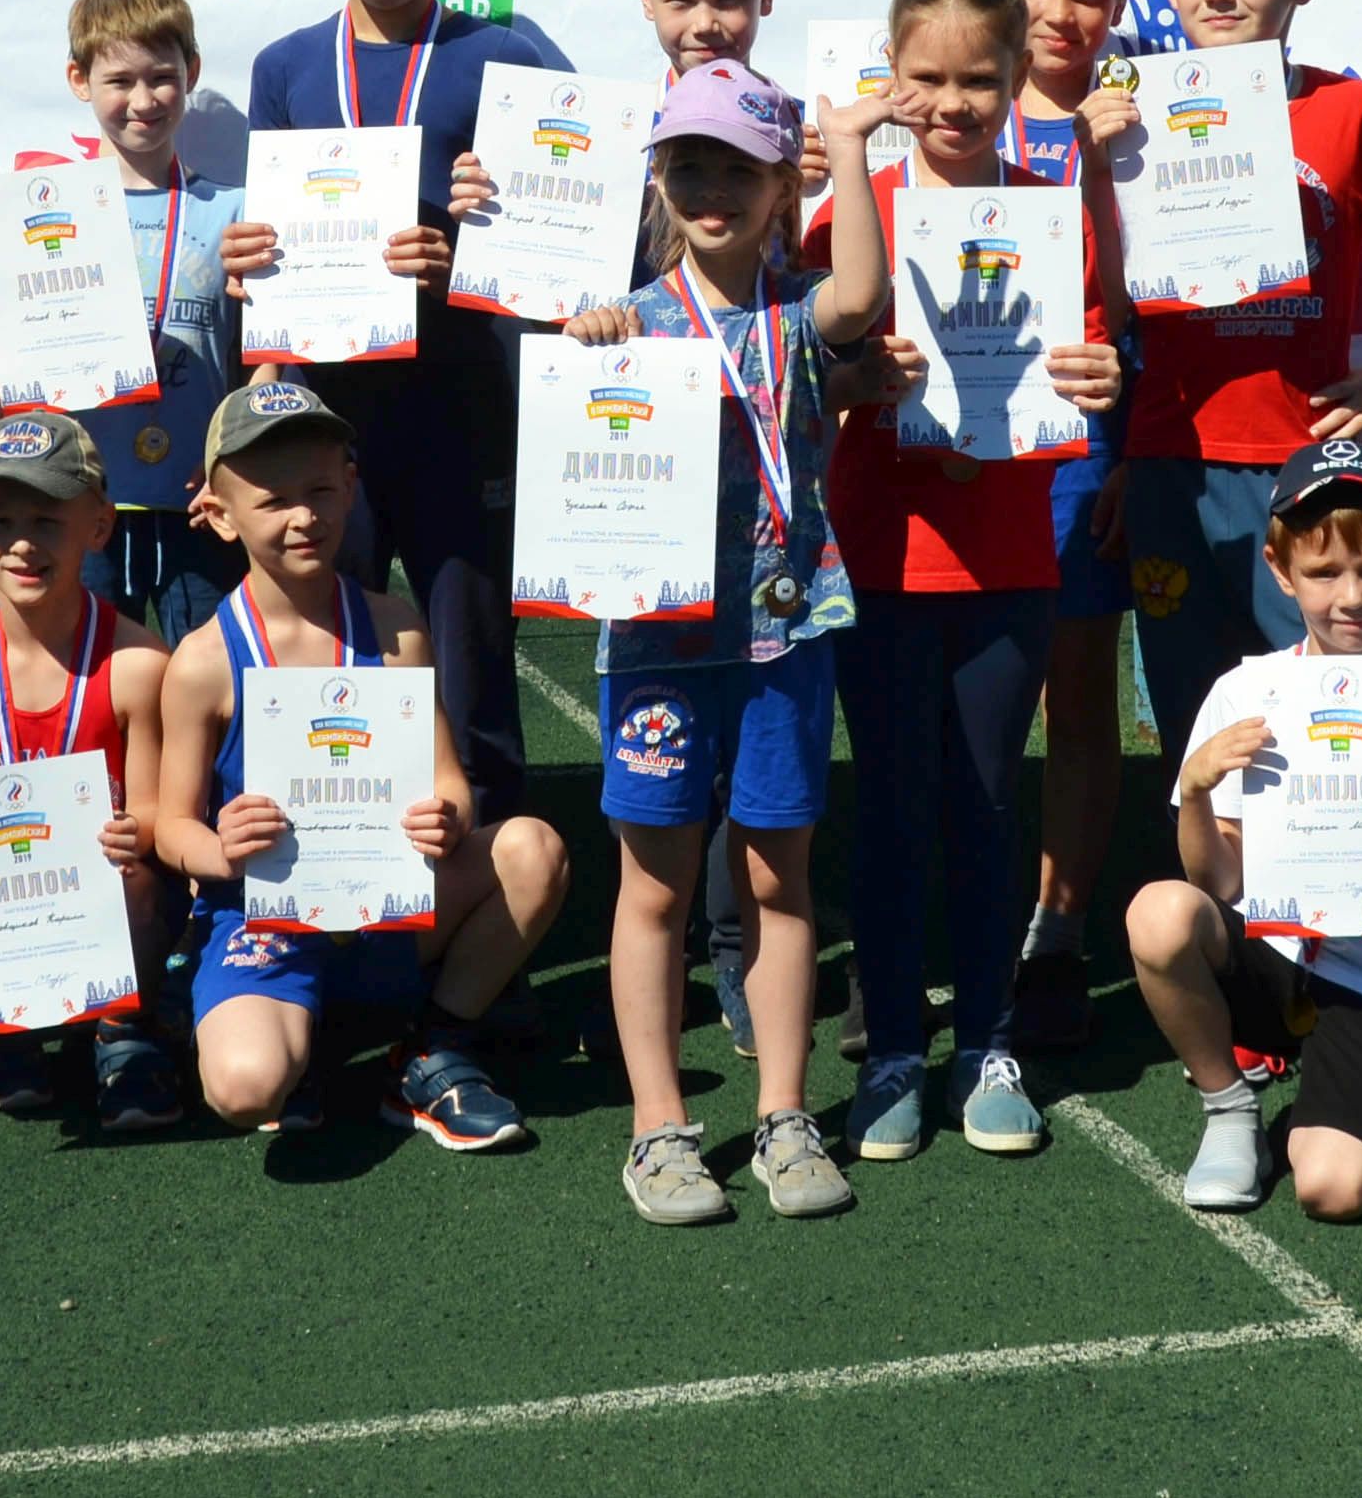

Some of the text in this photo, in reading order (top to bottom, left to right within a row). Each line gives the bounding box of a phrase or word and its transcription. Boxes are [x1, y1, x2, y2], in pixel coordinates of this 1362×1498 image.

[1191, 138, 1209, 148] 2019
[551, 158, 568, 167] 2019
[1155, 152, 1255, 192] ДИПЛОМ
[506, 171, 605, 206] ДИПЛОМ
[283, 219, 378, 247] ДИПЛОМ
[17, 263, 104, 301] ДИПЛОМ
[939, 301, 1043, 331] ДИПЛОМ
[609, 431, 629, 441] 2019
[562, 451, 674, 483] ДИПЛОМ
[330, 757, 349, 767] 2019
[1331, 752, 1351, 762] 2019
[287, 777, 392, 807] ДИПЛОМ
[14, 853, 33, 864] 2019
